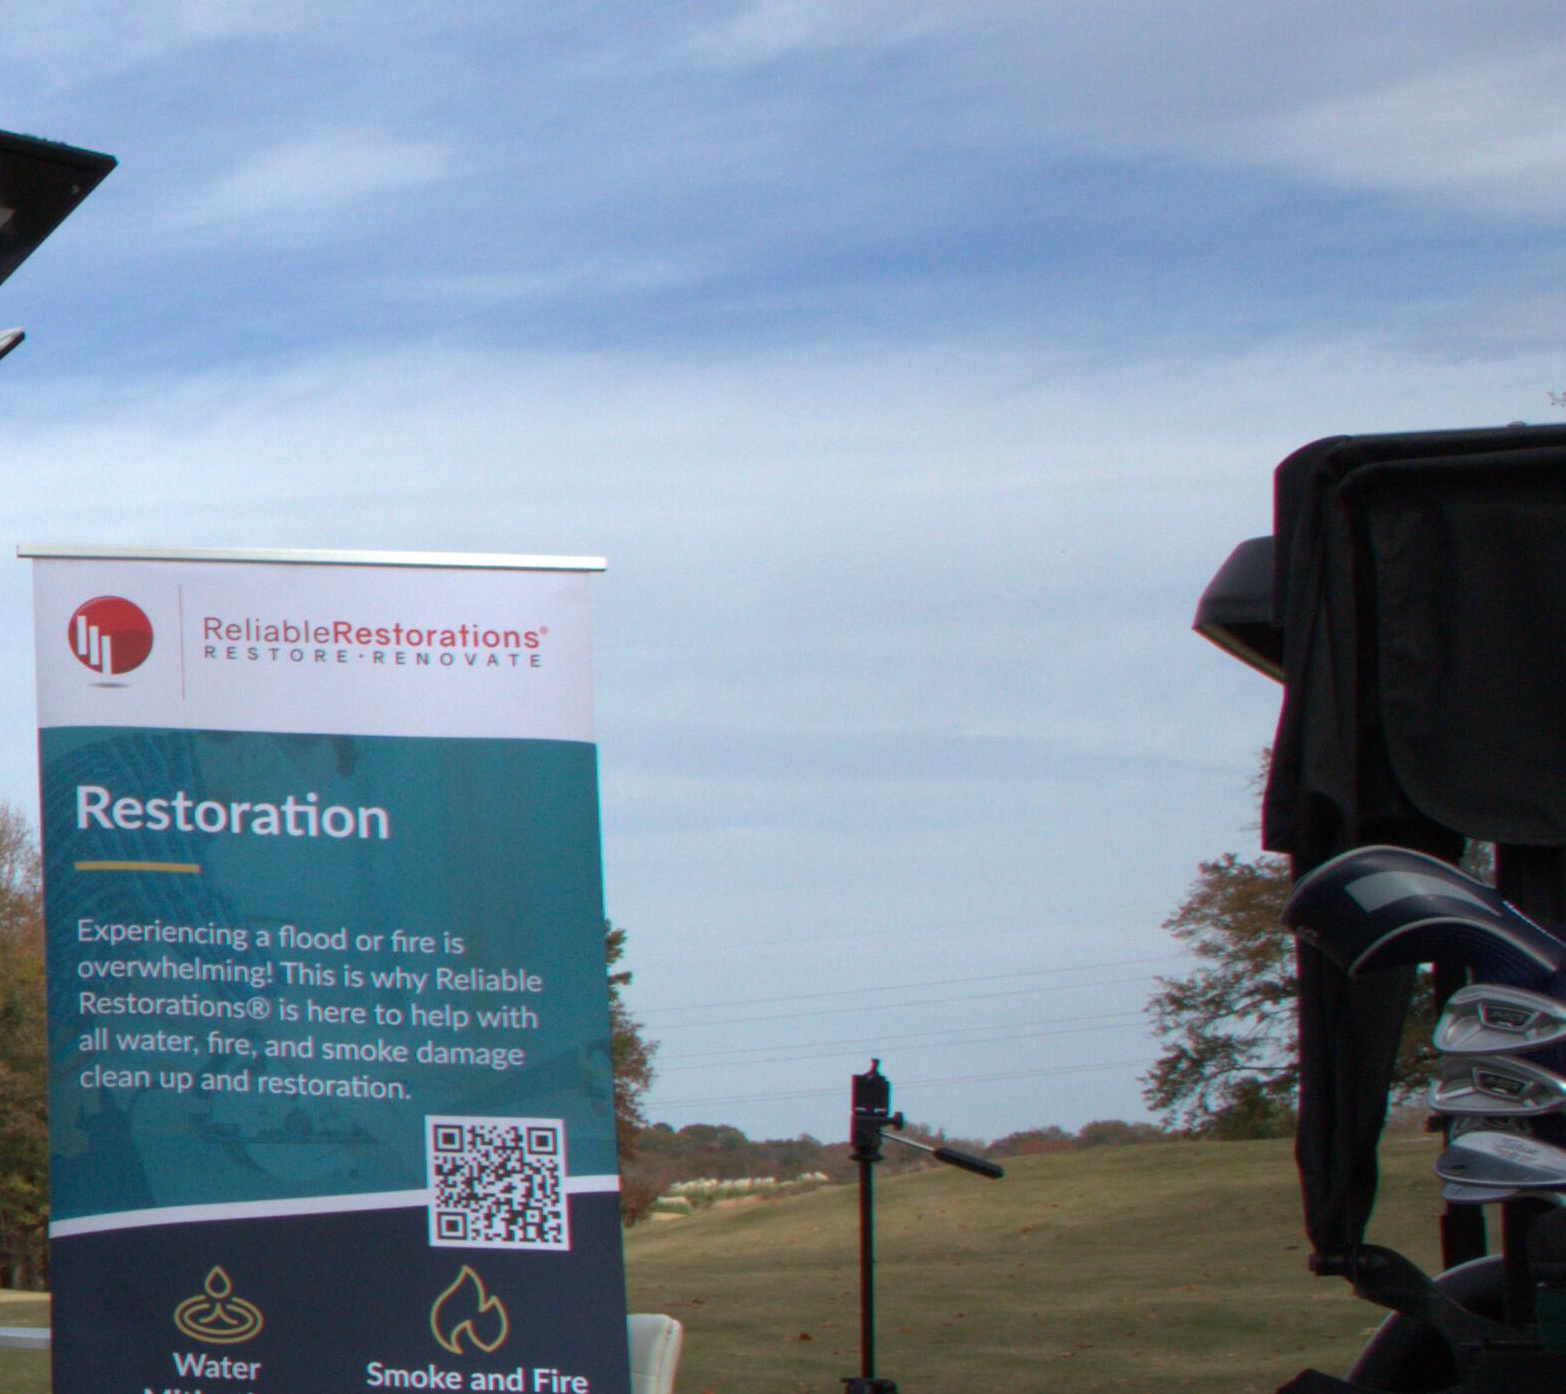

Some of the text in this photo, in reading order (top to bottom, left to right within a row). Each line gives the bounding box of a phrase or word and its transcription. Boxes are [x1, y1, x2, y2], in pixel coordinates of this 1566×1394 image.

[76, 786, 390, 839] Restoration
[78, 918, 464, 953] Experiencing a flood or fire is
[78, 958, 542, 995] overwhelming! This is why Reliable
[80, 993, 538, 1031] Restorations® is here to help with
[79, 1028, 524, 1071] all water, fire, and smoke damage
[80, 1066, 411, 1099] clean up and restoration.
[173, 1353, 261, 1381] Water
[367, 1363, 588, 1394] Smoke and Fire
